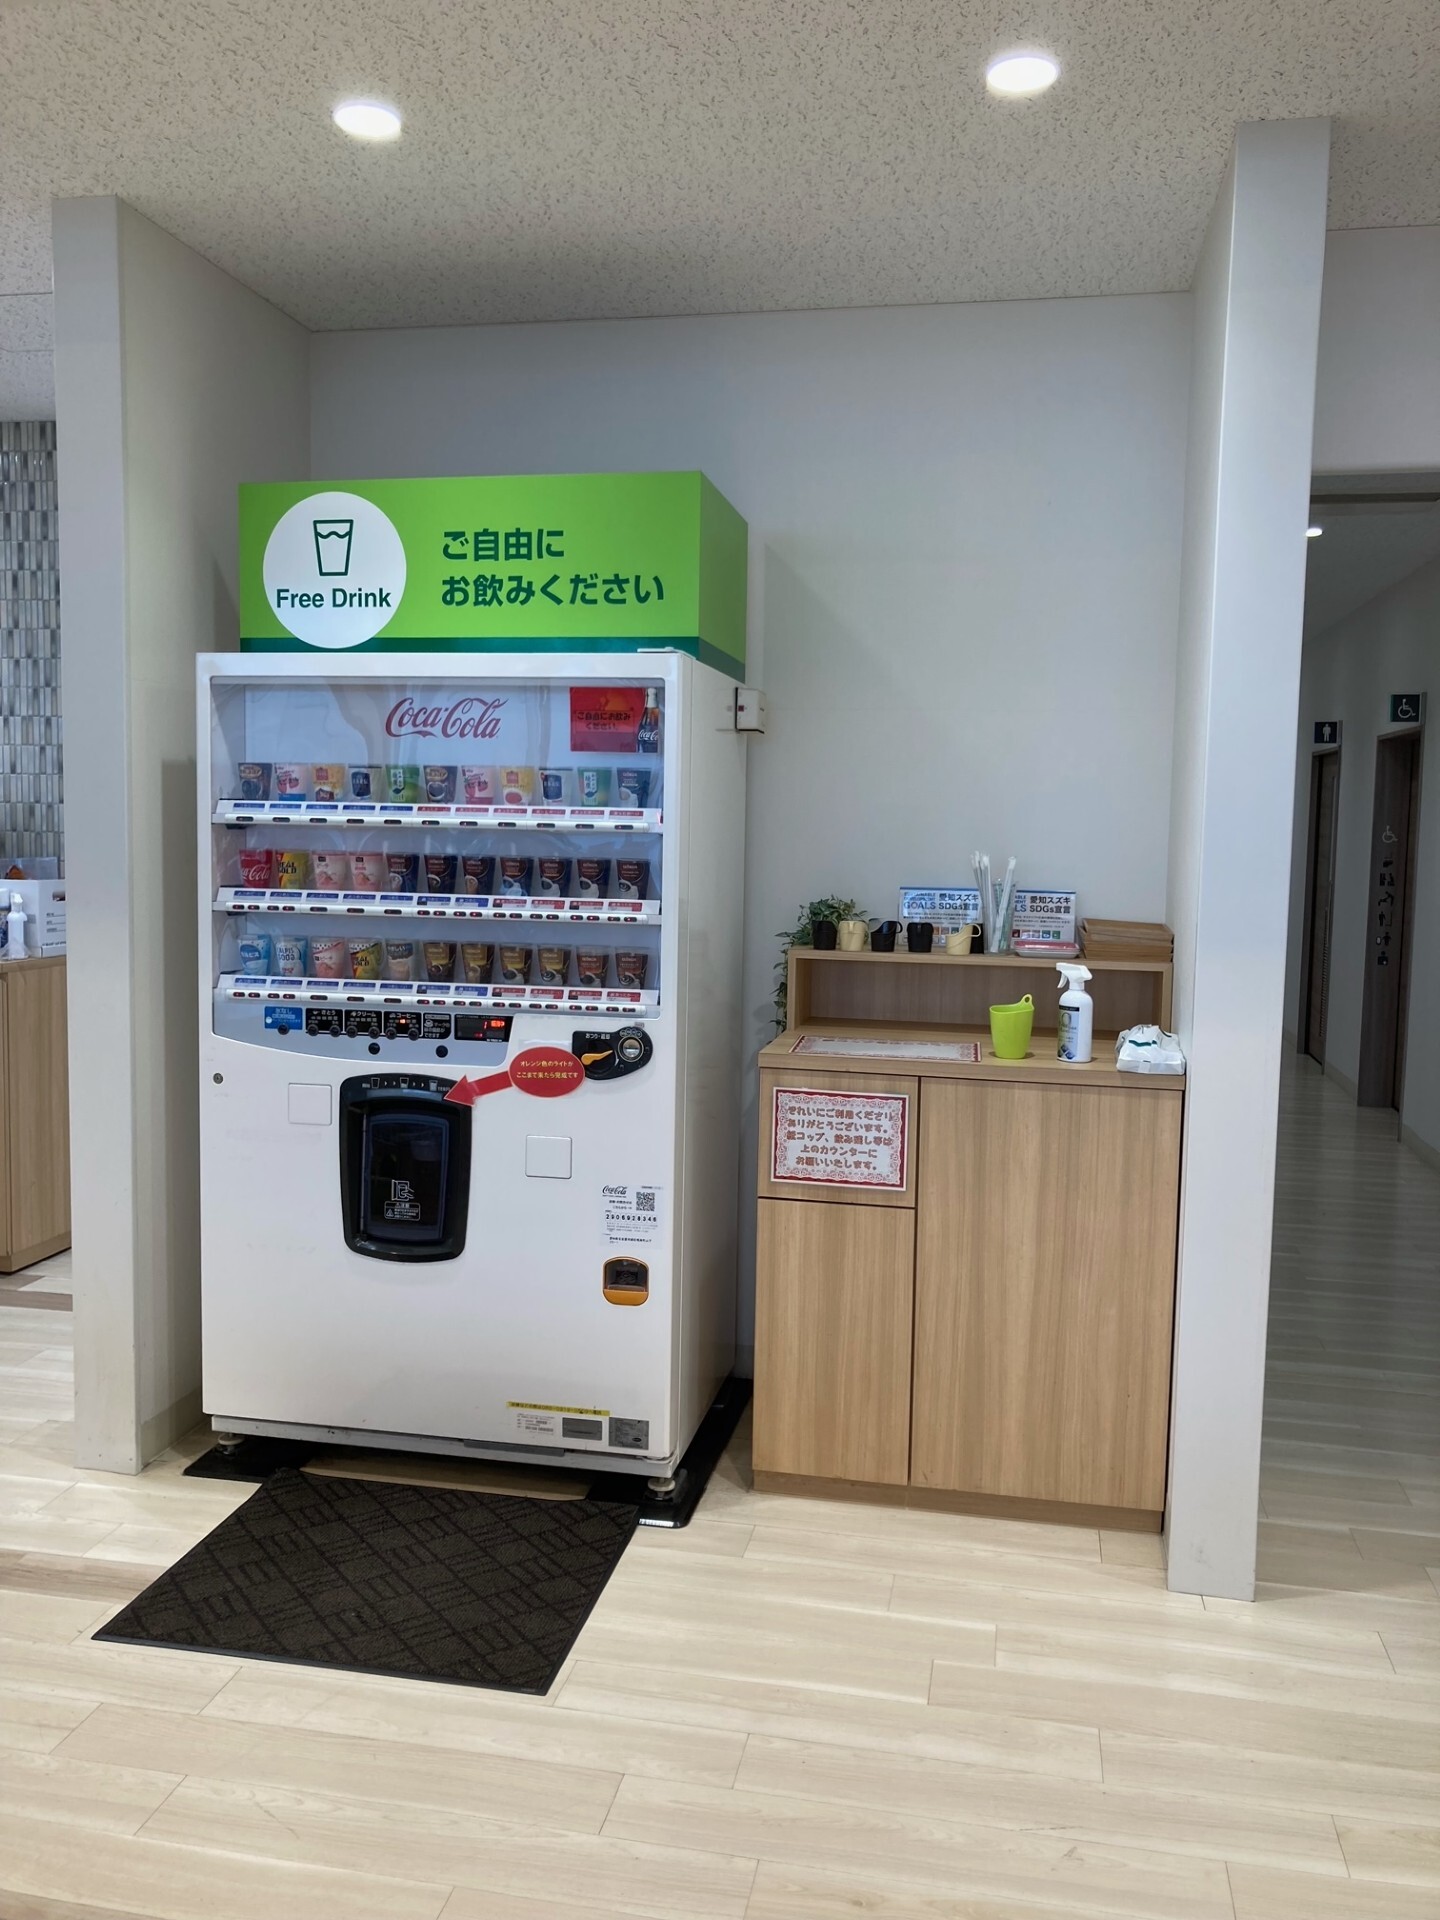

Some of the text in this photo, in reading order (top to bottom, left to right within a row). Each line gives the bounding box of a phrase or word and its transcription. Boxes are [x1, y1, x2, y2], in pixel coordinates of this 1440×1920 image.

[441, 528, 565, 562] ご自由に
[441, 573, 664, 607] お飲みください
[276, 587, 391, 609] Free Drink
[385, 697, 509, 739] Coca-Cola
[938, 893, 979, 902] 愛知スズキ
[1030, 895, 1071, 904] 愛知スズキ
[904, 901, 936, 910] GOALS
[938, 902, 979, 911] SDGs宣言
[1029, 904, 1071, 914] SDGs宣言
[516, 1071, 579, 1079] ここまで来たら完成です
[787, 1118, 888, 1133] ありがとうございます。
[786, 1130, 894, 1146] 紙コップ、飲み残し等は
[801, 1144, 878, 1158] 上のカウンターに
[795, 1156, 877, 1170] お願いいたします。
